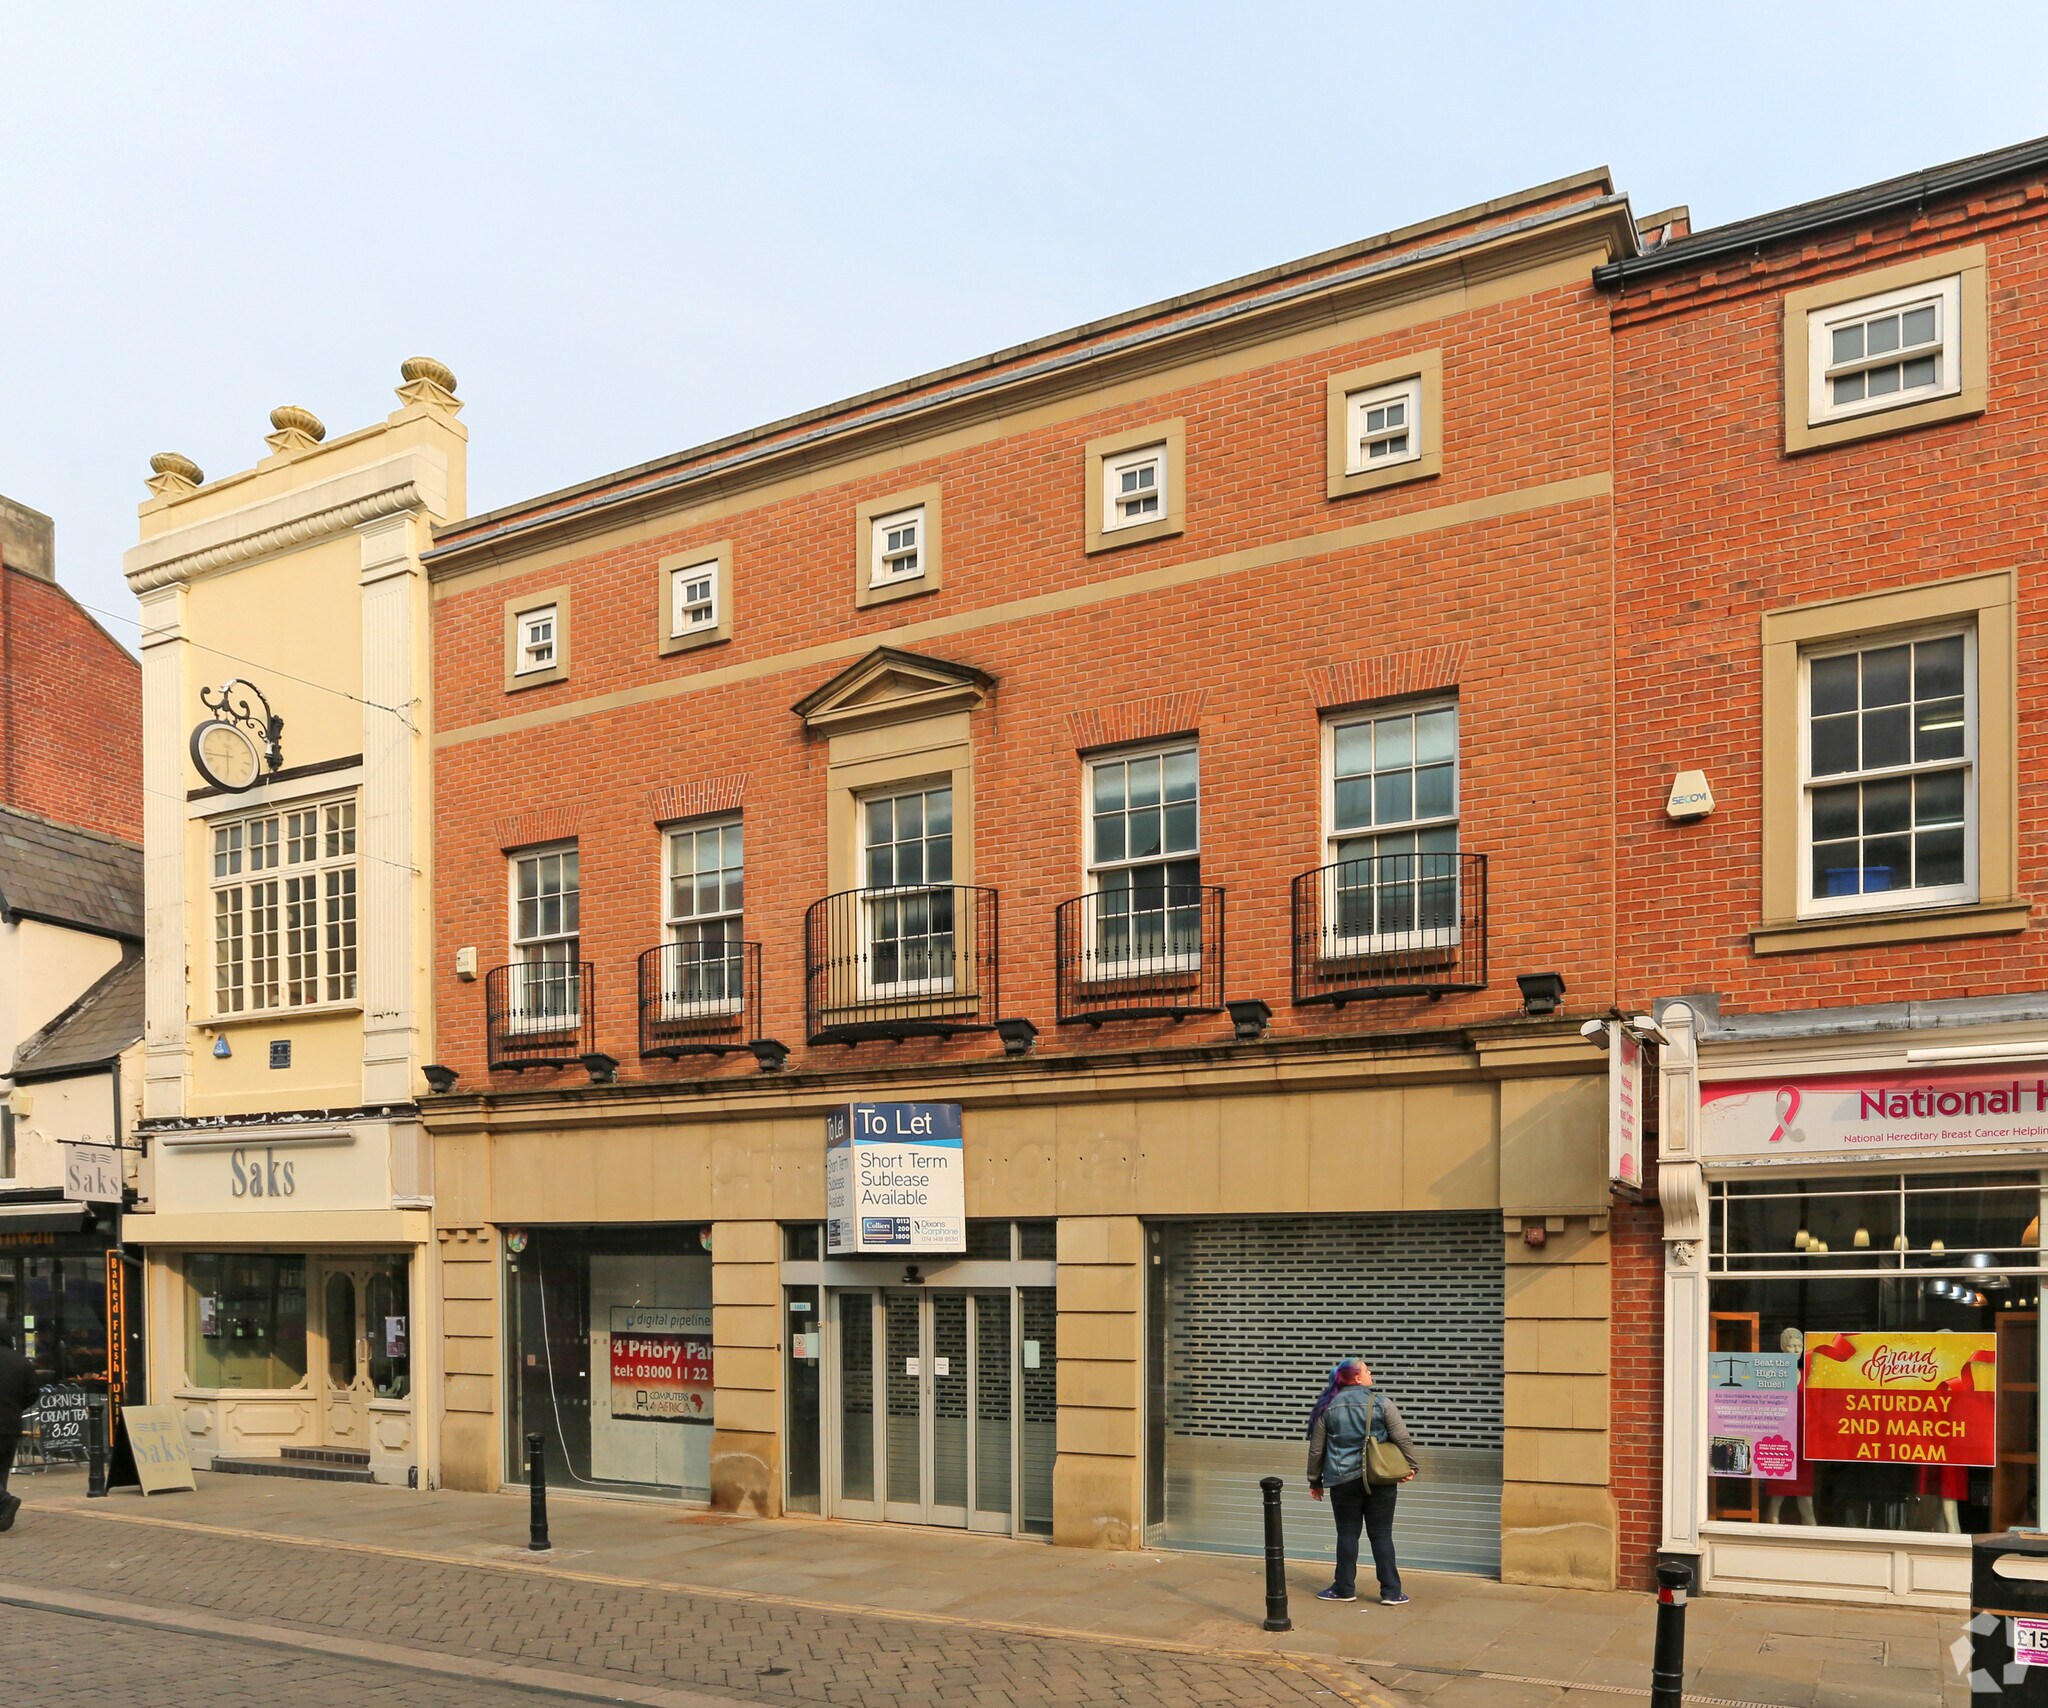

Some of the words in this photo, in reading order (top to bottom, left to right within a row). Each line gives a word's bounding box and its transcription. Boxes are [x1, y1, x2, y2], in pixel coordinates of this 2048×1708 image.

[1672, 793, 1707, 805] SECOM
[1860, 1080, 2020, 1120] National
[857, 1108, 887, 1134] To
[896, 1109, 932, 1135] Let
[1844, 1133, 1884, 1143] National
[1887, 1130, 1938, 1141] Hereditary
[1941, 1129, 1972, 1139] Breast
[1975, 1128, 2010, 1138] Cancer
[860, 1151, 903, 1168] Short
[908, 1152, 948, 1168] Term
[69, 1164, 119, 1195] Saks
[231, 1146, 295, 1198] Saks
[861, 1170, 930, 1187] Sublease
[861, 1189, 928, 1205] Available
[921, 1220, 946, 1228] Dixons
[921, 1227, 959, 1236] Carphone
[111, 1258, 119, 1314] Baked
[637, 1314, 667, 1328] digital
[670, 1314, 711, 1328] pipeline
[613, 1339, 624, 1357] 4
[628, 1340, 681, 1364] Priory
[1872, 1344, 1938, 1366] Grand
[1754, 1358, 1774, 1367] Beat
[1775, 1359, 1790, 1367] the
[614, 1365, 634, 1377] tel:
[636, 1364, 672, 1379] 03000
[693, 1367, 708, 1380] 22
[1756, 1370, 1776, 1378] High
[1778, 1370, 1788, 1378] St
[1861, 1359, 1939, 1386] Opening
[1758, 1380, 1785, 1388] Blues!
[40, 1393, 86, 1409] CORNISH
[650, 1391, 689, 1401] COMPUTERS
[1845, 1394, 1952, 1413] SATURDAY
[40, 1410, 70, 1423] CREAM
[70, 1408, 88, 1421] TEA
[656, 1402, 692, 1414] AFRICA
[52, 1422, 80, 1438] 3.50
[1838, 1418, 1880, 1435] 2ND
[1886, 1419, 1966, 1438] MARCH
[132, 1435, 187, 1464] Saks
[1856, 1442, 1881, 1459] AT
[1888, 1443, 1947, 1462] 10AM
